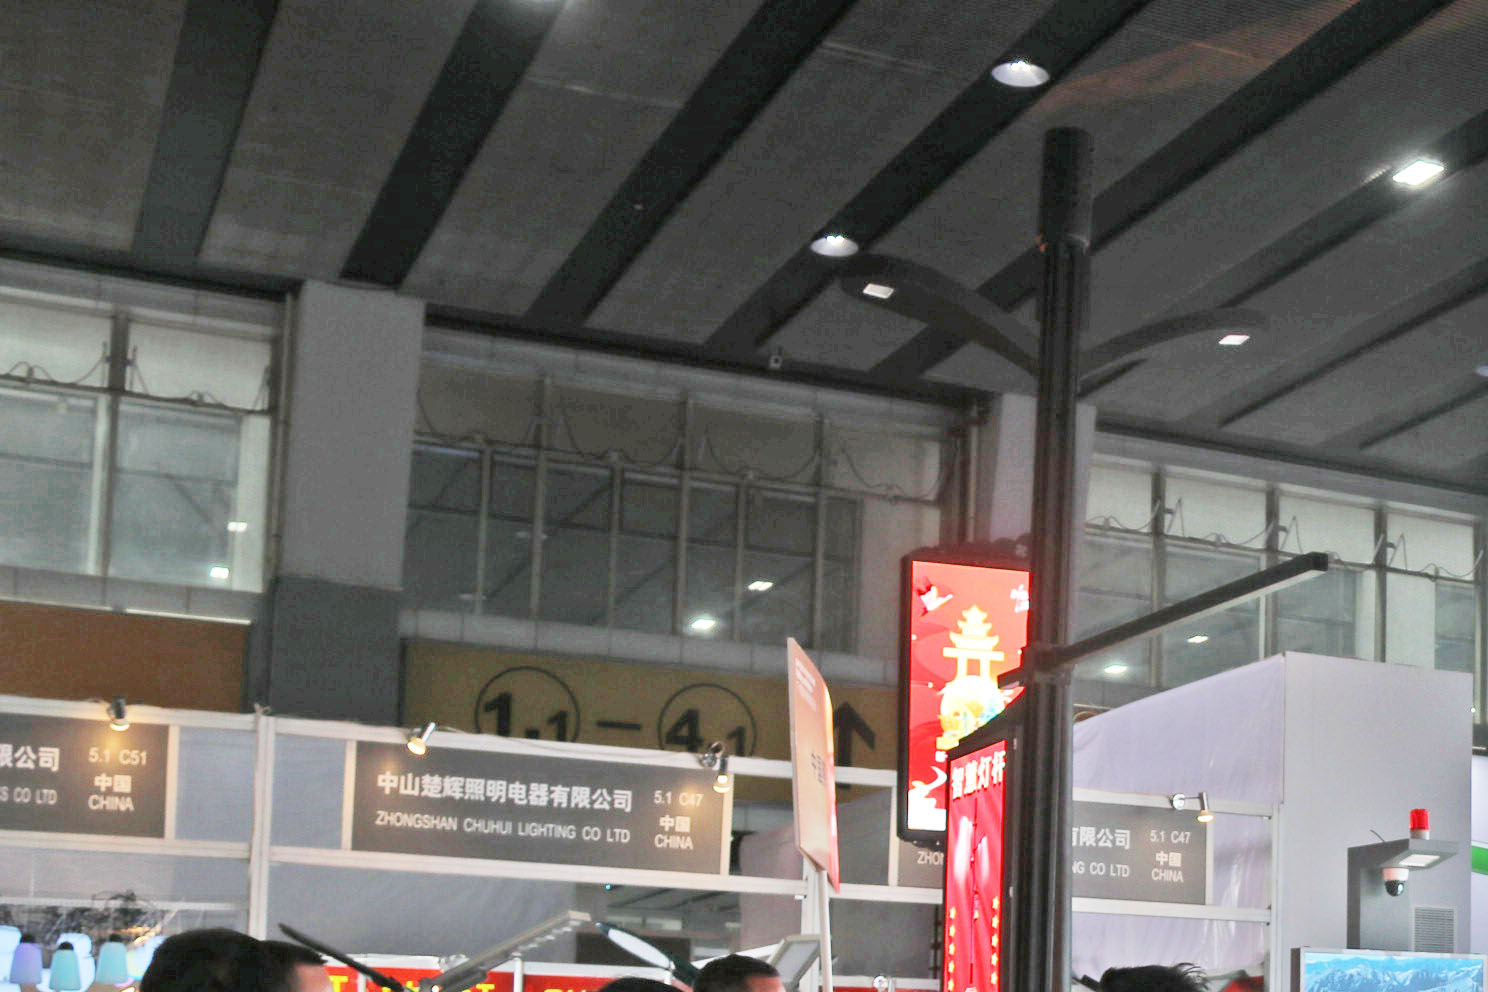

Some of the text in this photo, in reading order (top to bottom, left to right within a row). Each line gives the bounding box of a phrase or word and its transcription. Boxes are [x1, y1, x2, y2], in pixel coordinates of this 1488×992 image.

[88, 747, 148, 766] 5.1 C51
[94, 773, 133, 794] 中国
[376, 772, 634, 813] 中山楚辉照明电器有限公司
[13, 787, 32, 803] CO
[36, 789, 58, 805] LTD
[88, 794, 135, 812] CHINA
[654, 790, 673, 805] 5.1
[374, 810, 632, 844] ZHONGSHAN CHUHUI LIGHTING CO LTD
[659, 815, 690, 833] 中国
[654, 833, 694, 851] CHINA
[1149, 829, 1192, 845] 5.1 C47
[1155, 850, 1182, 868] 中国
[1089, 861, 1106, 876] CO
[1110, 863, 1130, 878] LTD
[1151, 868, 1184, 883] CHINA
